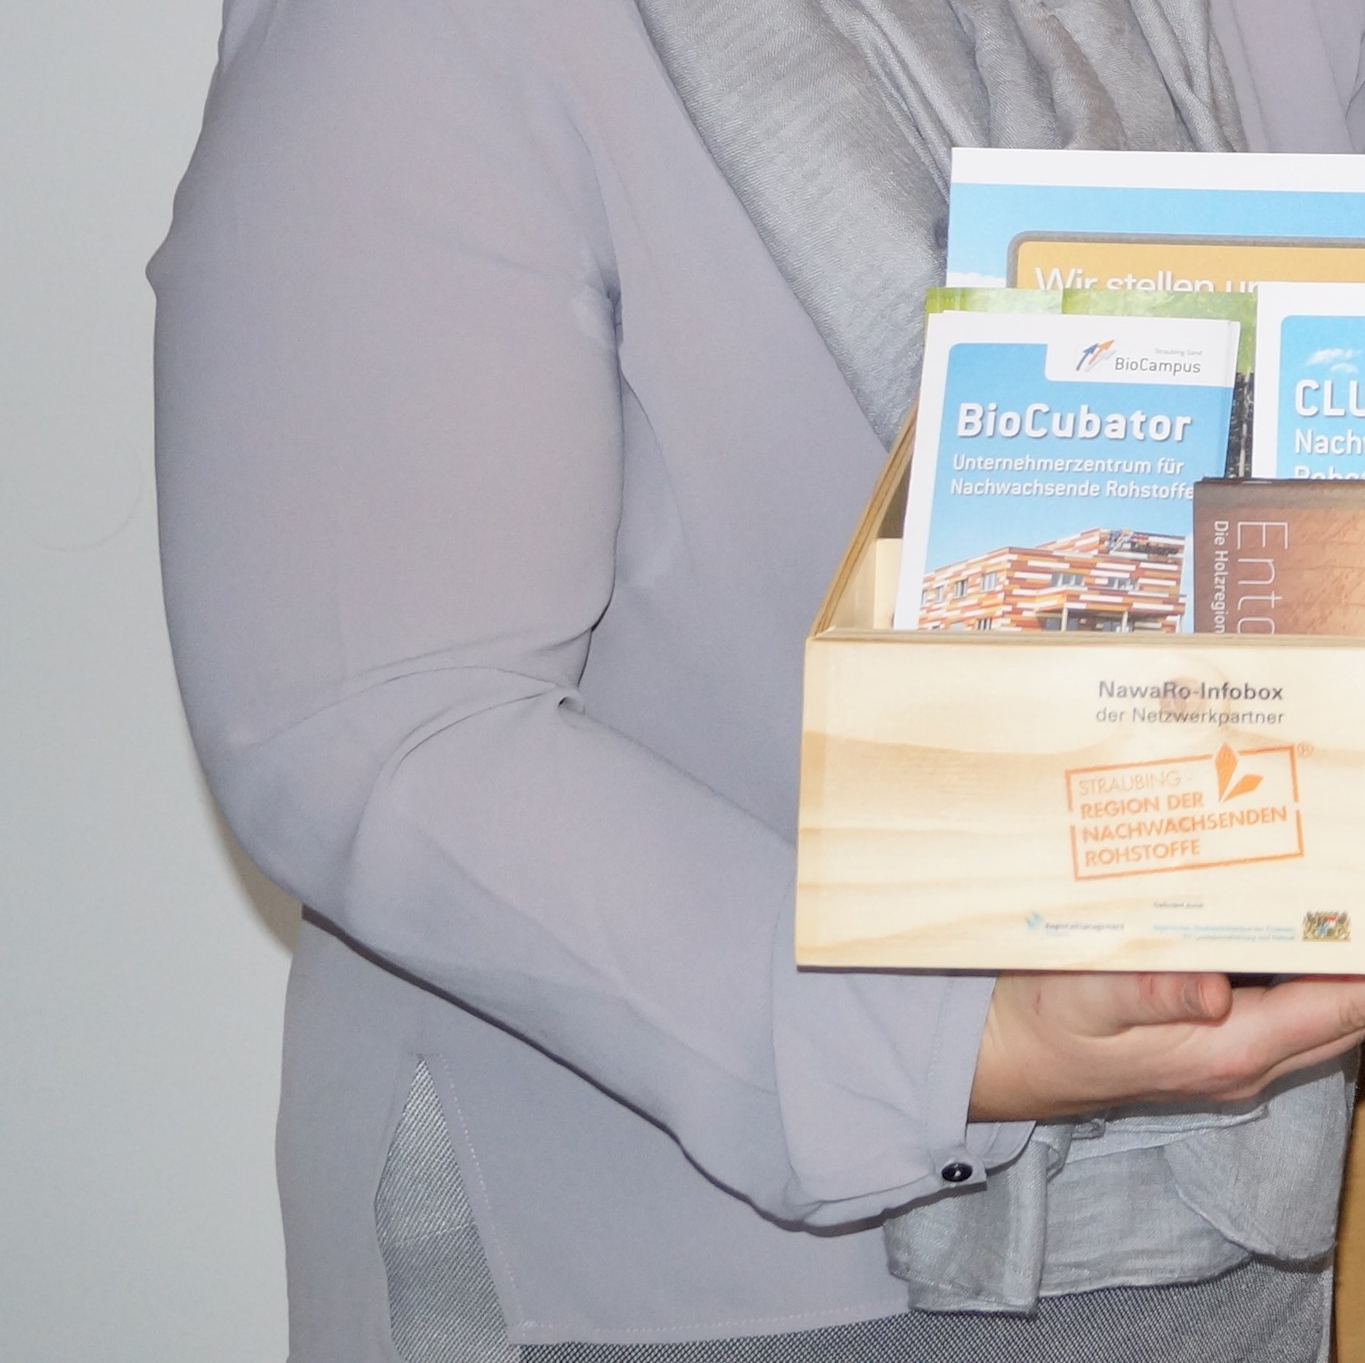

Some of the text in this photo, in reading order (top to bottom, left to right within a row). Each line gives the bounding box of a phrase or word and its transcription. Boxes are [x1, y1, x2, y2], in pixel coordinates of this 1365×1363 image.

[1035, 267, 1098, 290] Wir
[1115, 357, 1201, 376] BioCampus
[957, 402, 1191, 441] BioCubator
[953, 454, 1185, 474] Unternehmerzentrum für
[951, 479, 1194, 499] Nachwachsende Rohstoffe
[1211, 520, 1229, 634] Die Holzregion
[1098, 680, 1284, 701] NawaRo-Infobox
[1096, 707, 1285, 726] der Netzwerkpartner
[1078, 769, 1182, 796] STRAUBING
[1080, 792, 1205, 820] REGION DER
[1083, 806, 1287, 843] NACHWACHSENDEN
[1085, 840, 1200, 867] ROHSTOFFE
